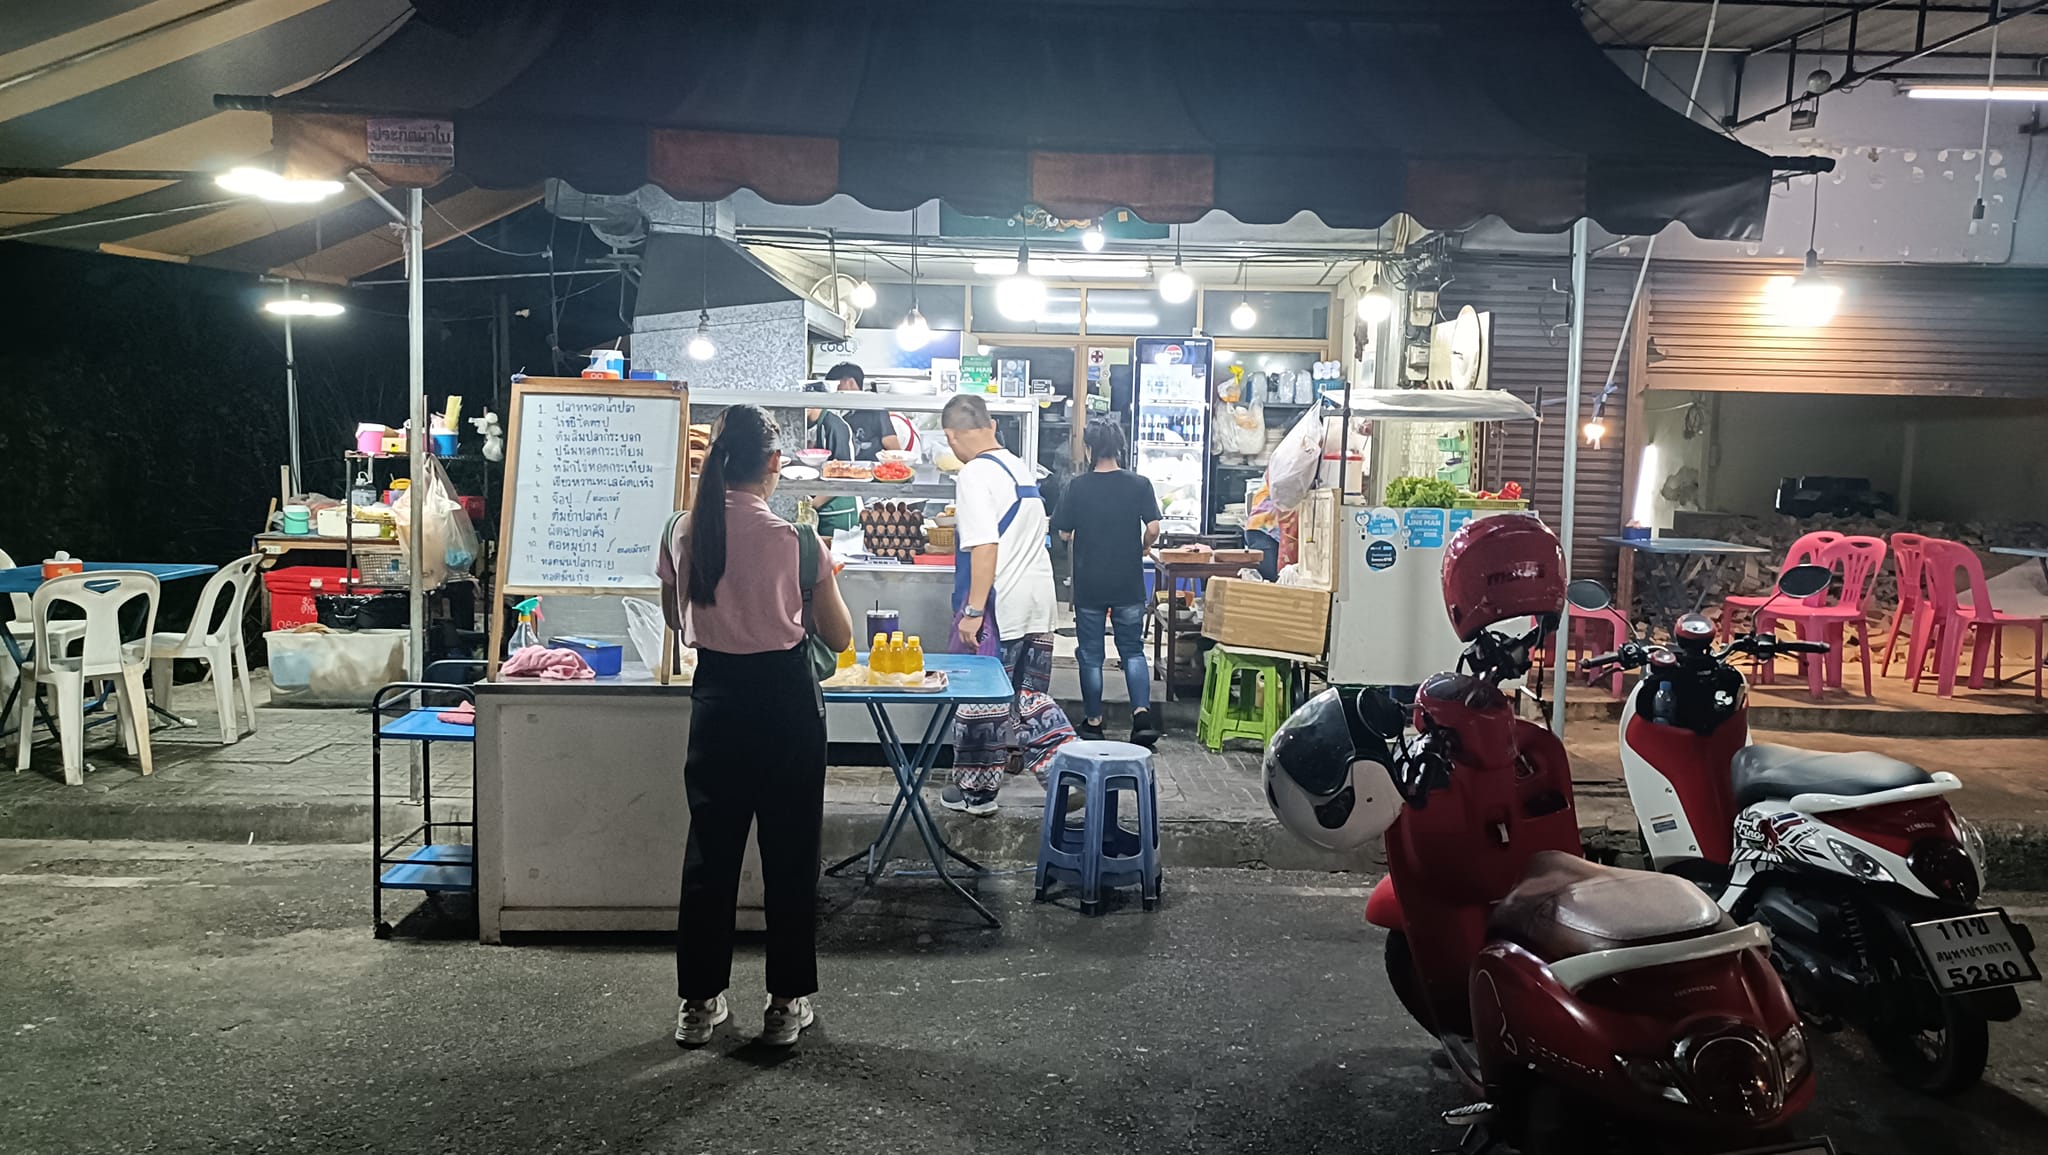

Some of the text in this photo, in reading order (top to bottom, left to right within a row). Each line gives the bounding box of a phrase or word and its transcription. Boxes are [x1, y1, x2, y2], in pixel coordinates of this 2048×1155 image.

[1736, 818, 1766, 842] Fino
[1935, 941, 2012, 964] สมุทรปราการ
[1947, 960, 2021, 987] 5280
